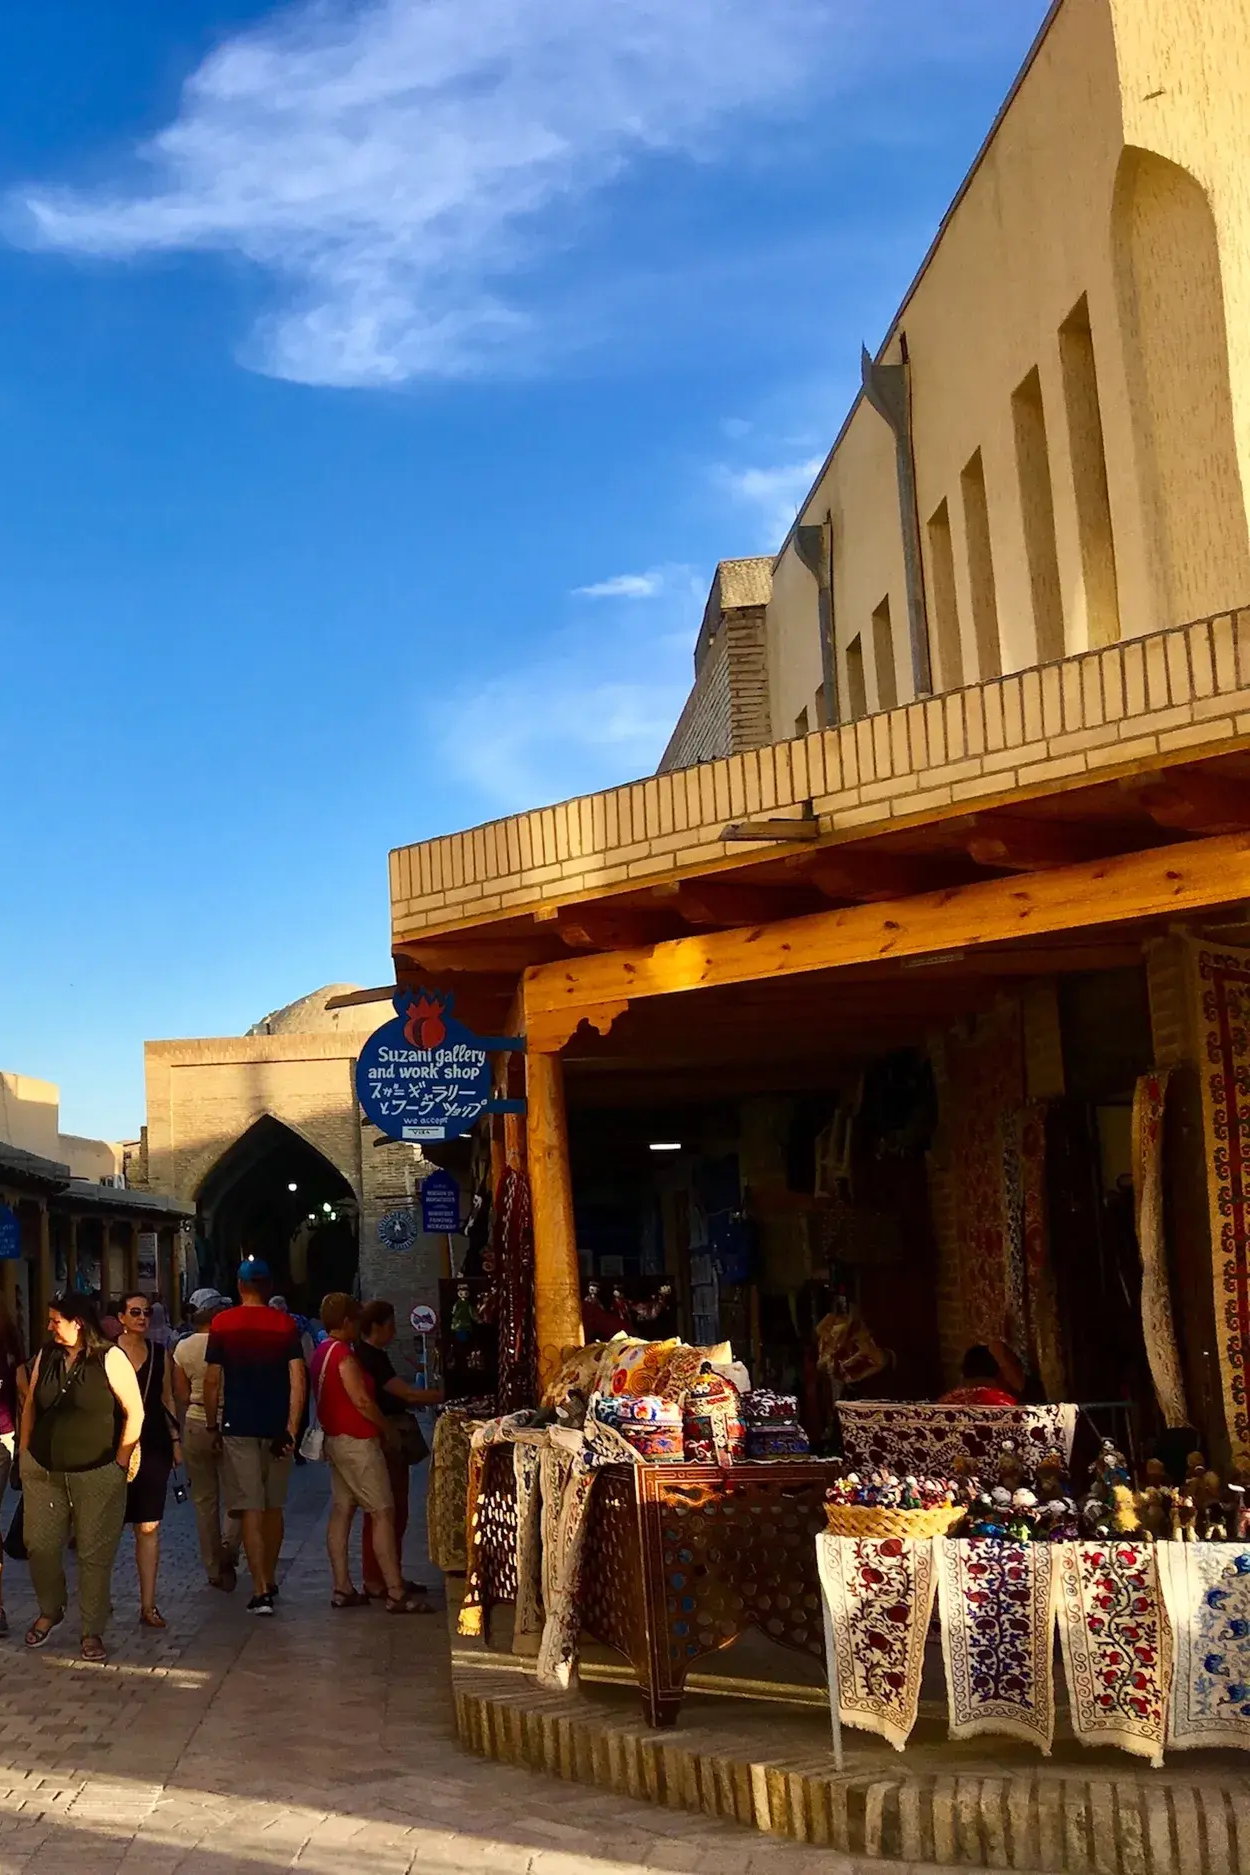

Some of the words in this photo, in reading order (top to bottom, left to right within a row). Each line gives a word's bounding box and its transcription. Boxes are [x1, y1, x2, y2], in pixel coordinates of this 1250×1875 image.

[378, 1046, 432, 1063] Suzani
[435, 1044, 486, 1067] gallery
[368, 1064, 395, 1079] and
[444, 1064, 480, 1080] shop
[419, 1117, 448, 1126] accept
